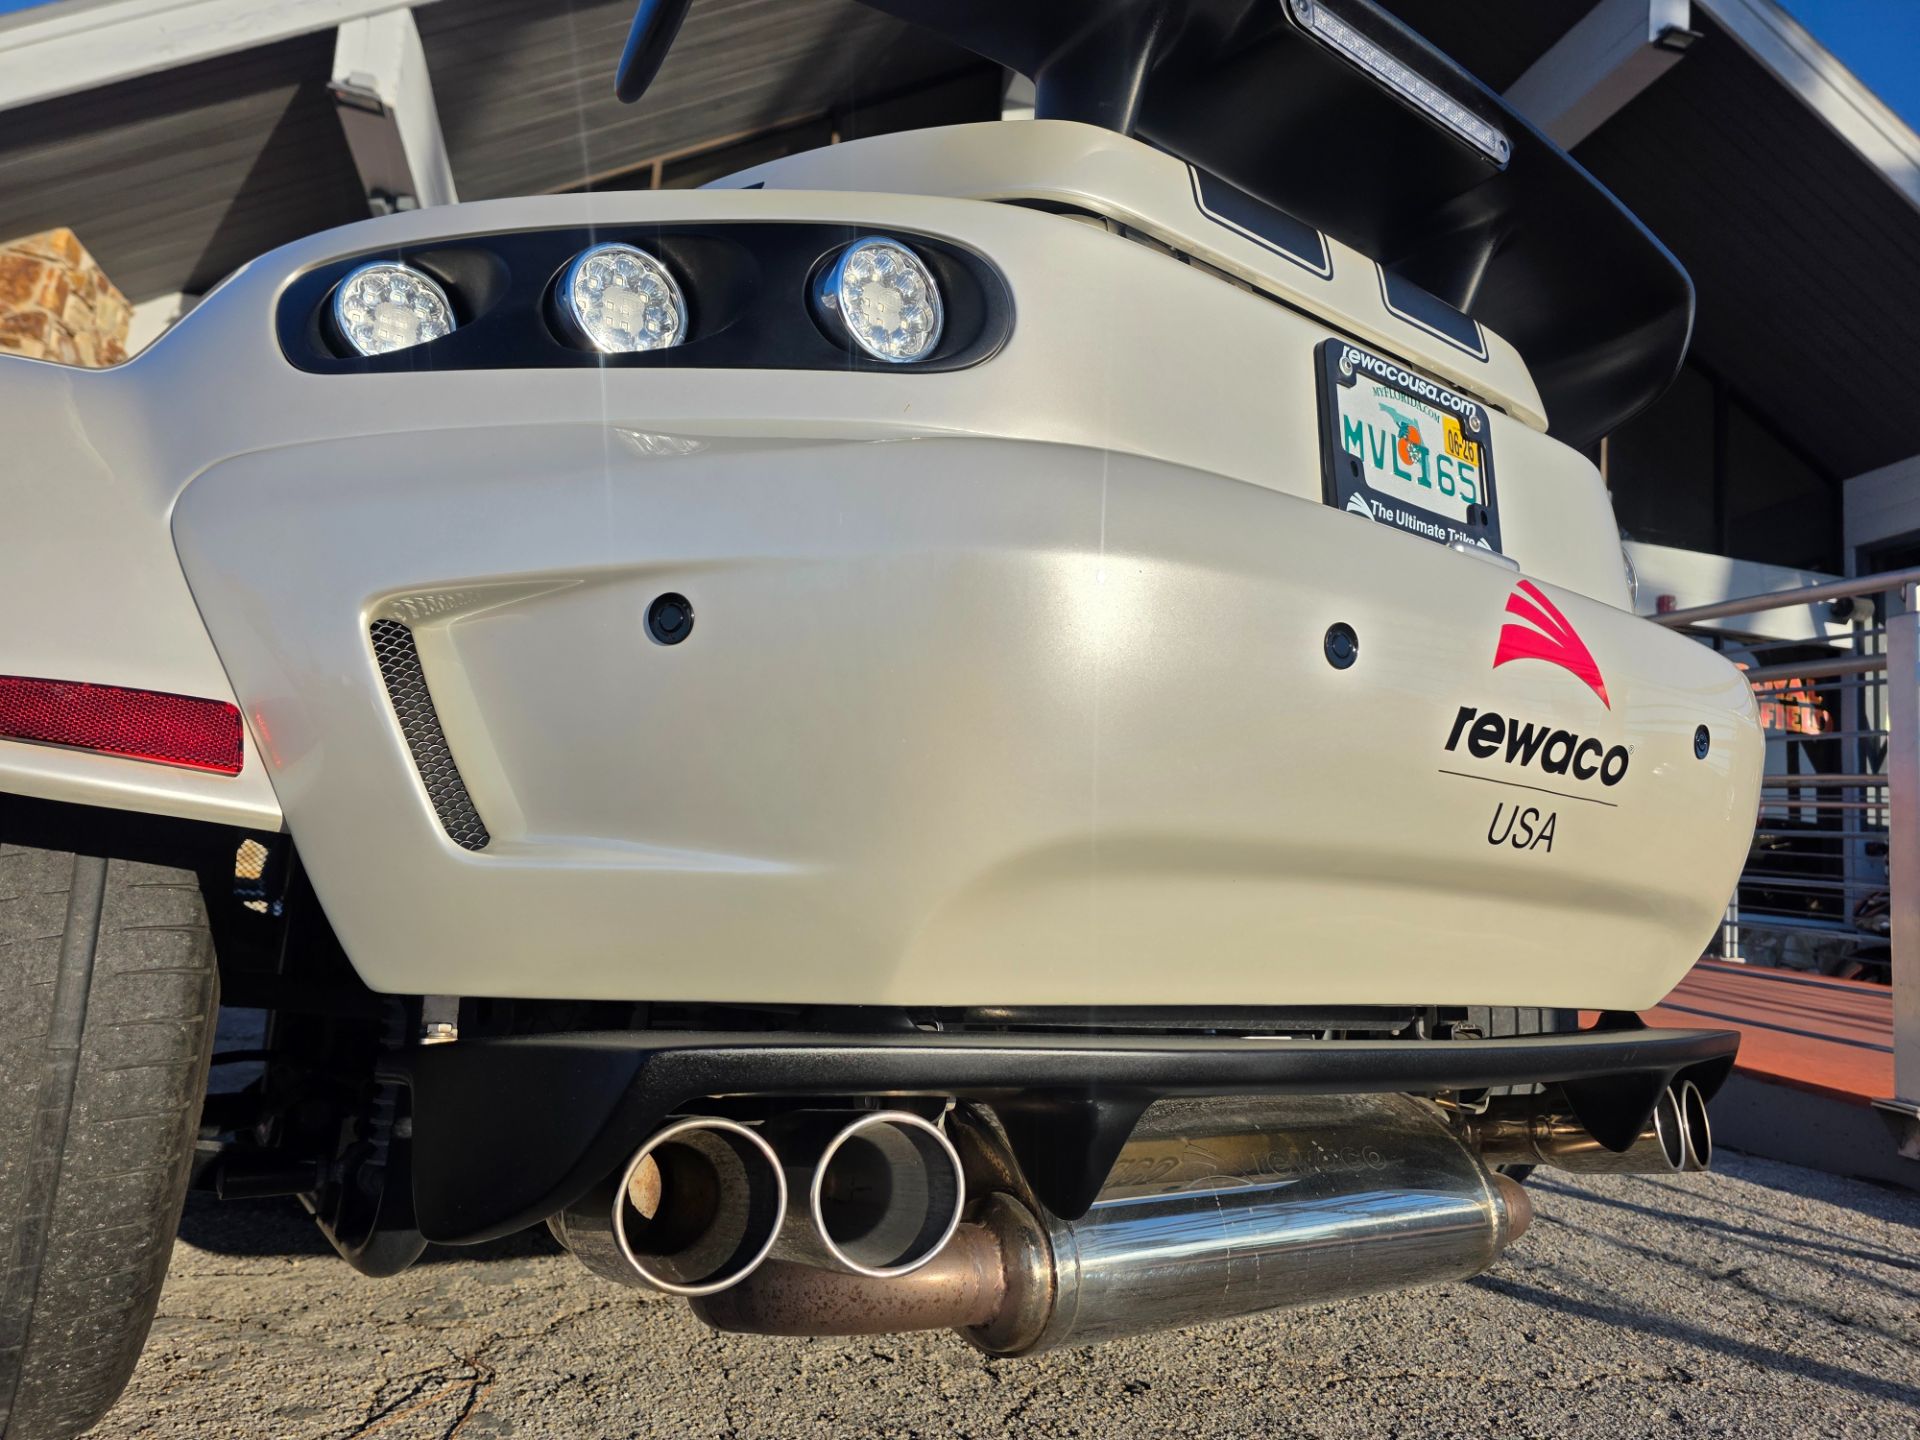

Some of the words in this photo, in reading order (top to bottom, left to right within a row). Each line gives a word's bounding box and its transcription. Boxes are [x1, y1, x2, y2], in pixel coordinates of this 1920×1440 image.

[1342, 345, 1477, 416] rewacousa.com
[1372, 386, 1441, 424] MYFLORIDA.COM
[1370, 499, 1394, 522] The
[1395, 509, 1446, 541] Ultimate
[1487, 802, 1557, 853] USA
